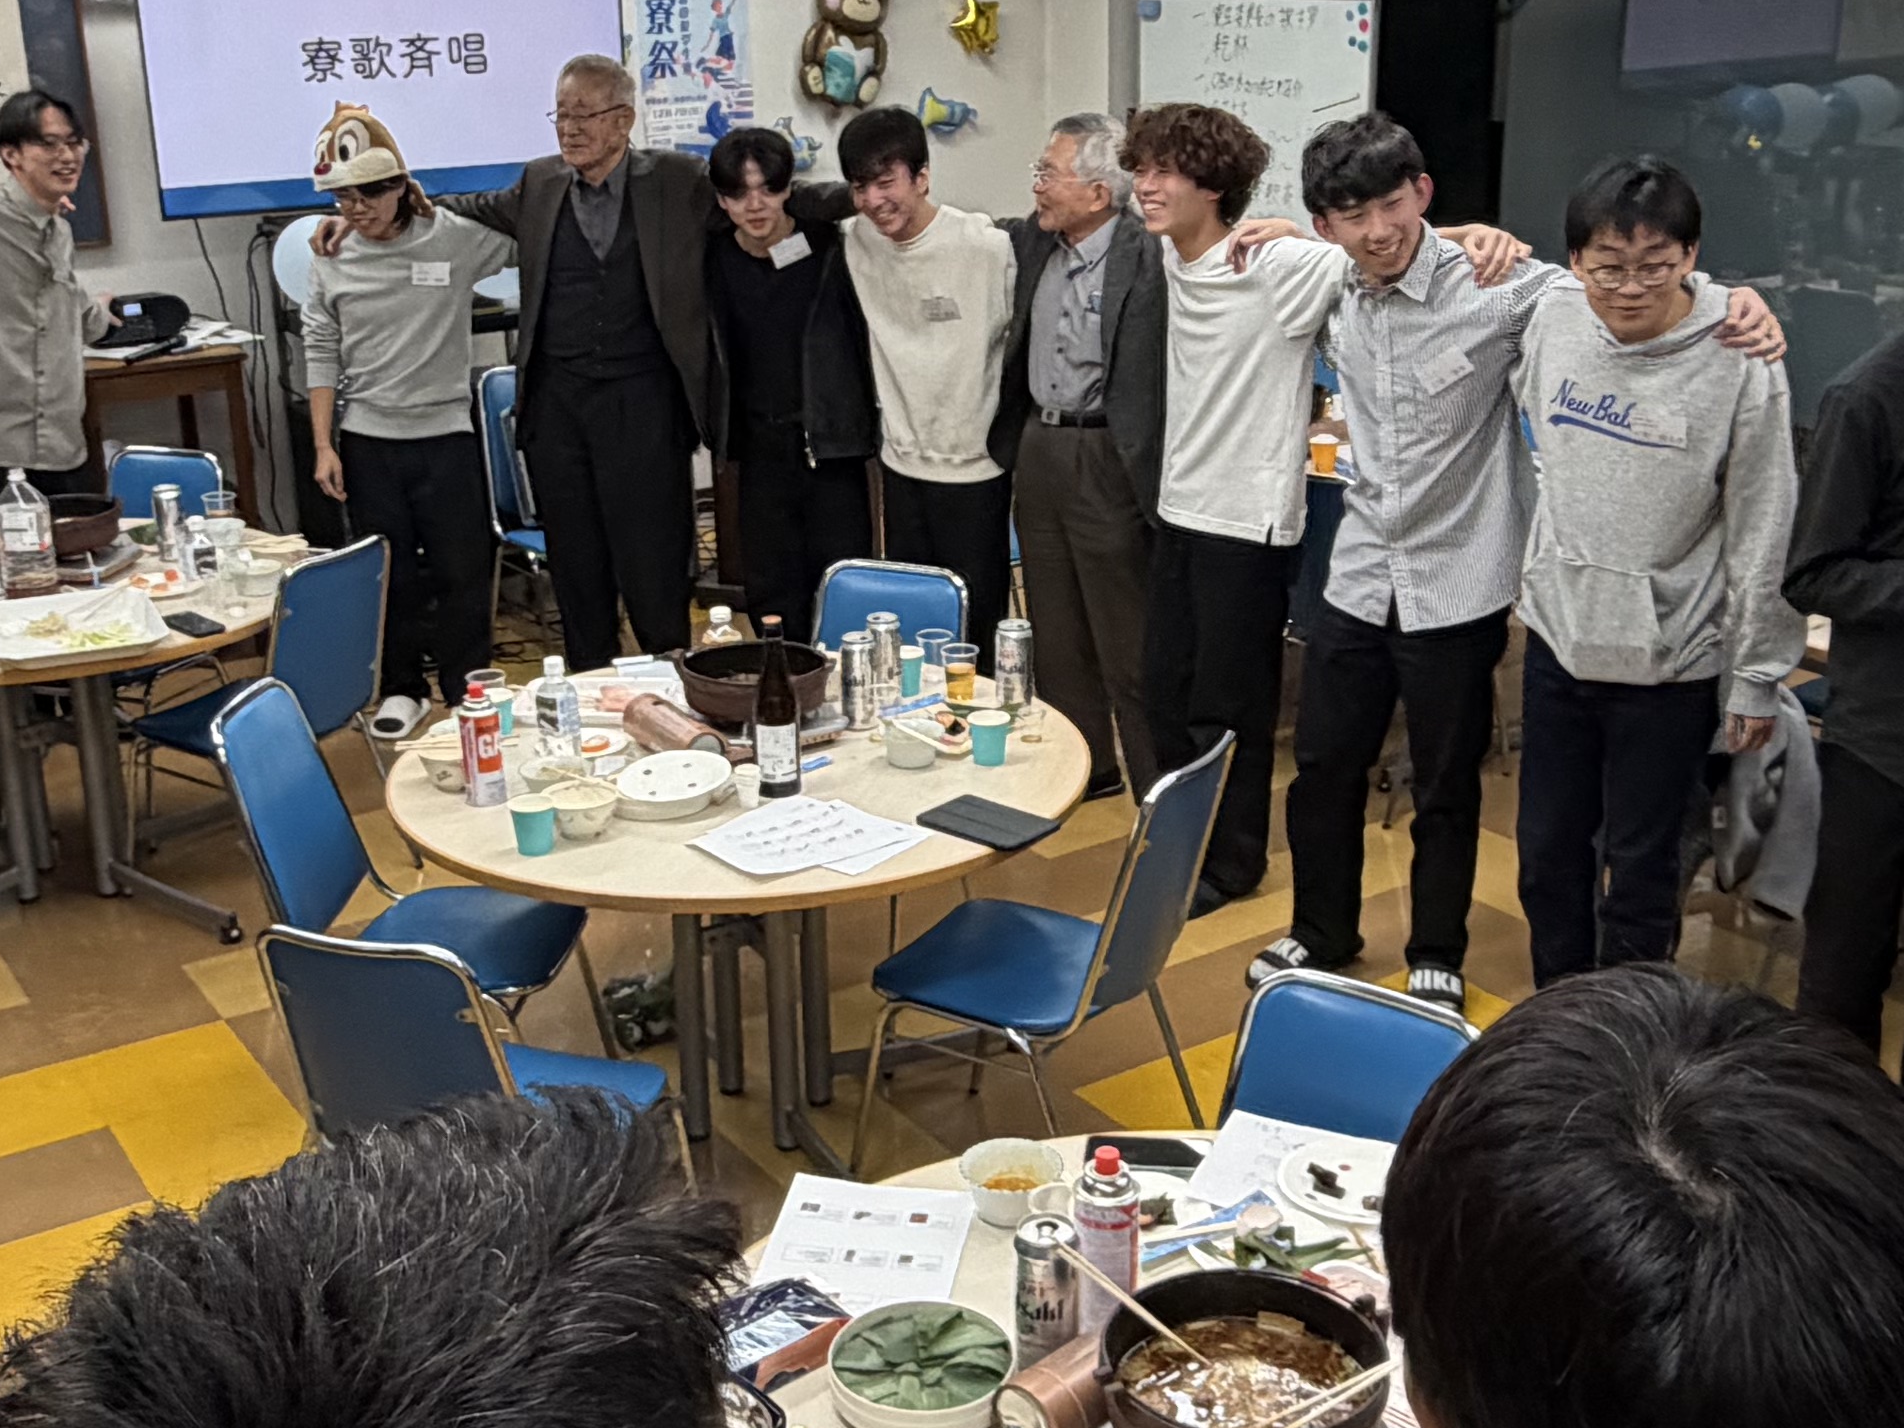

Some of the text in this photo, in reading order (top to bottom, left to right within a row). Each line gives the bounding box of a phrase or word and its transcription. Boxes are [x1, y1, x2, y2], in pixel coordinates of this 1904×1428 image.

[301, 32, 488, 83] 寮歌斉唱
[1550, 377, 1638, 430] New Bal
[1409, 969, 1464, 997] NIKE
